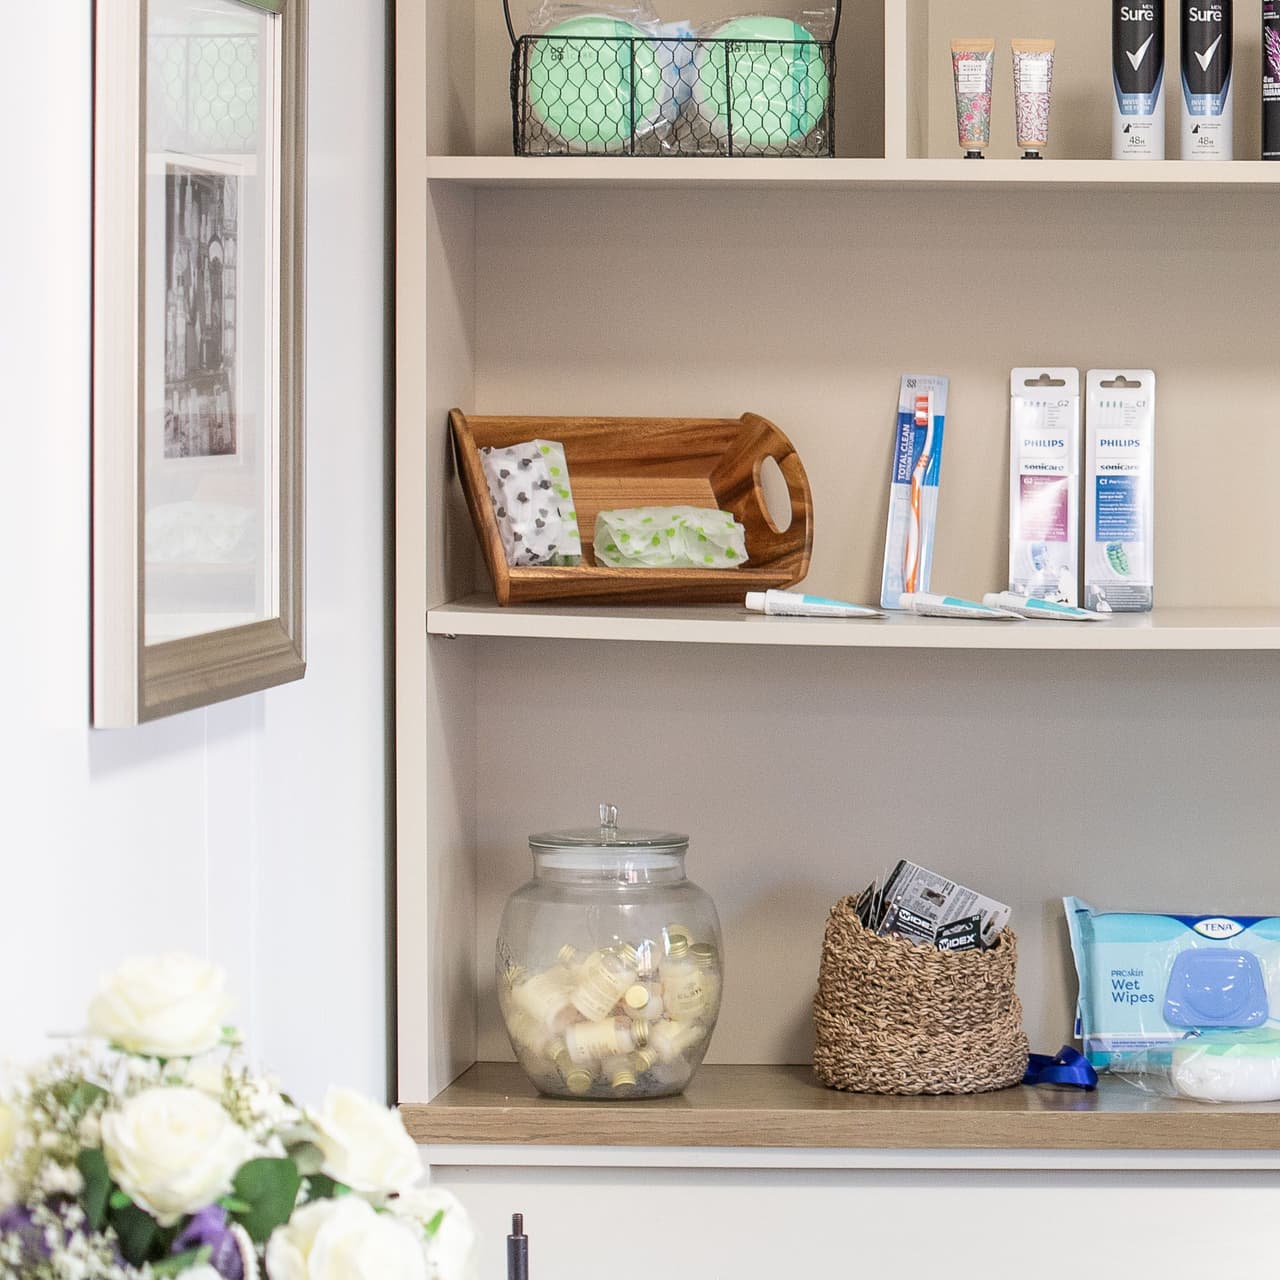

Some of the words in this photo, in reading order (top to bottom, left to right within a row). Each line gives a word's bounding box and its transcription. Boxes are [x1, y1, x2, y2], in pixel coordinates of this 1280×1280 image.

[1120, 6, 1154, 21] Sure
[1189, 7, 1222, 22] Sure
[900, 423, 911, 452] CLEAN
[1024, 439, 1064, 447] PHILIPS
[1100, 439, 1140, 447] PHILIPS
[897, 453, 908, 481] TOTAL
[1024, 463, 1064, 471] sonicare
[1202, 923, 1235, 931] TENA
[938, 933, 977, 951] WIDEX
[1111, 979, 1140, 990] Wet
[1111, 991, 1155, 1005] Wipes
